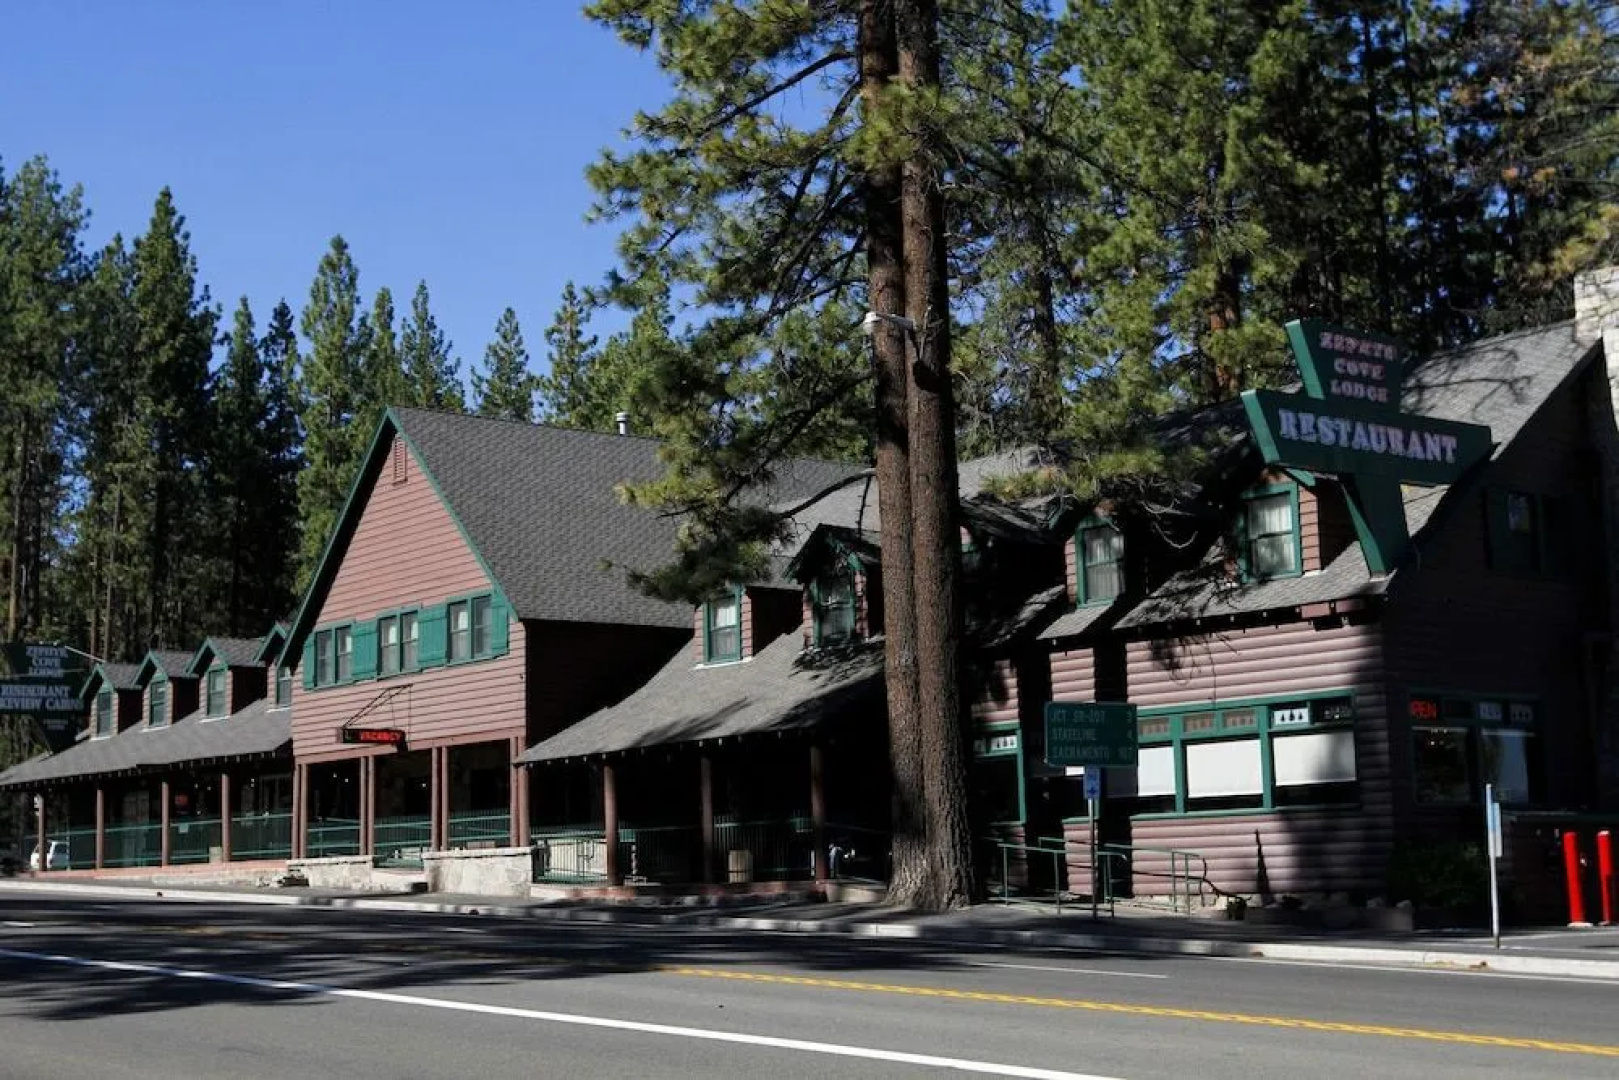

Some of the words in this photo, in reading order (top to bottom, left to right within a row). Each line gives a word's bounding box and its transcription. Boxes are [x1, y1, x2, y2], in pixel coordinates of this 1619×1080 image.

[1334, 357, 1386, 381] COVE
[1330, 379, 1390, 402] LODGE
[1278, 408, 1458, 463] RESTAURANT
